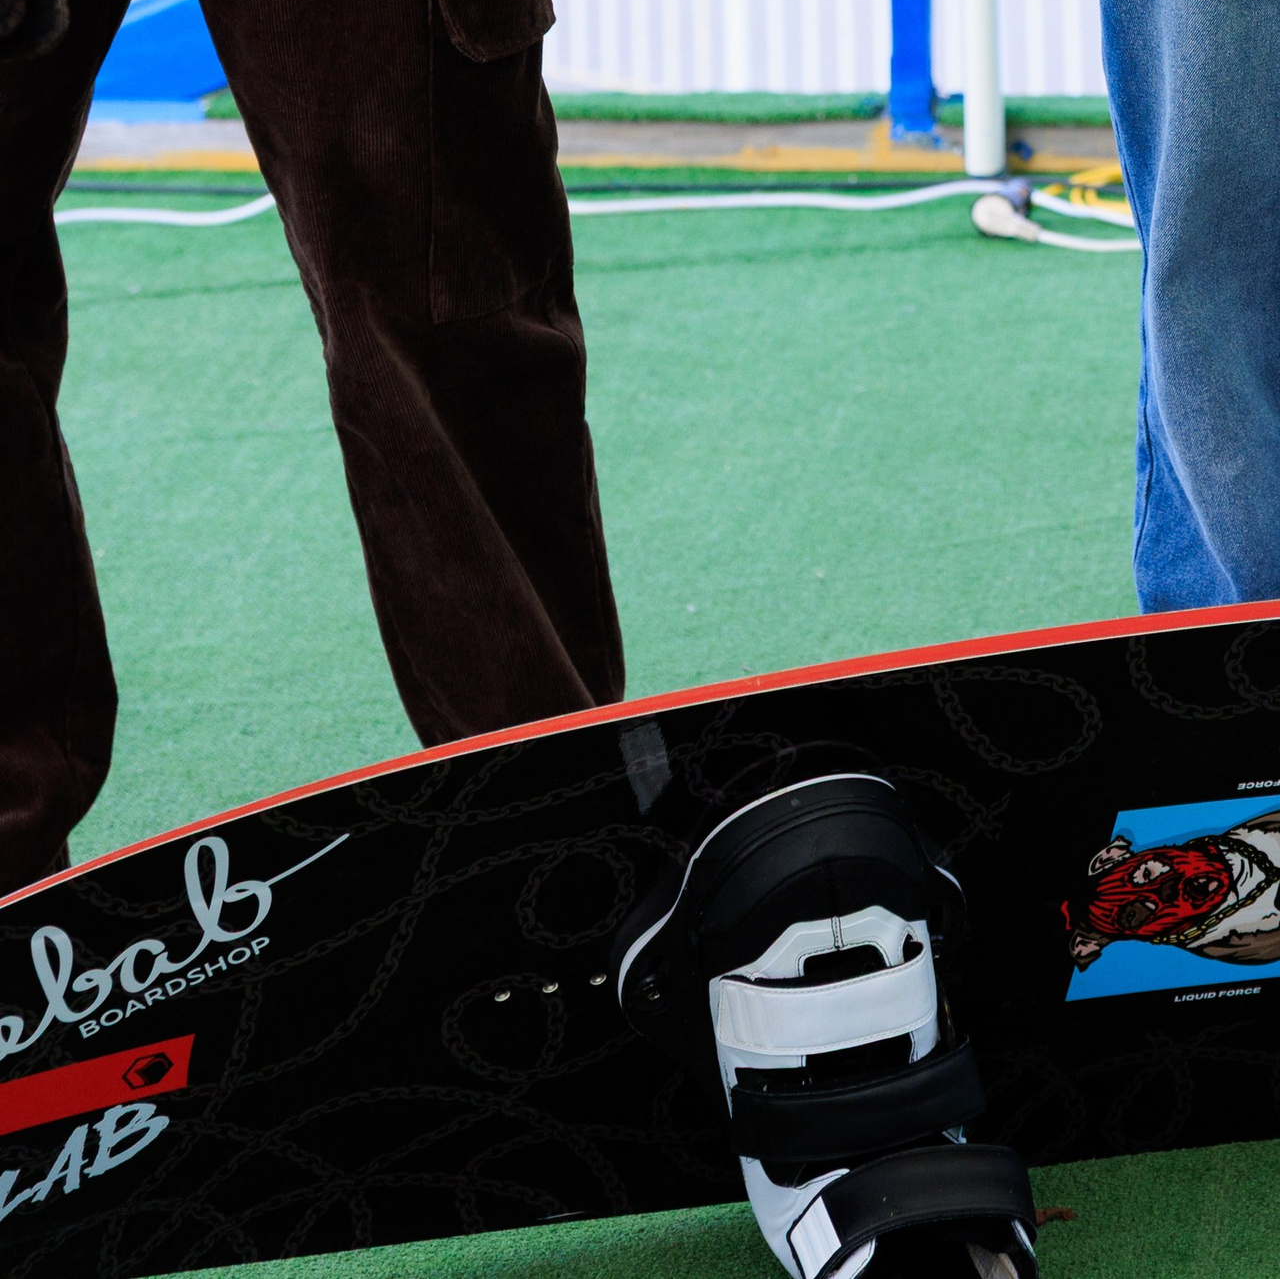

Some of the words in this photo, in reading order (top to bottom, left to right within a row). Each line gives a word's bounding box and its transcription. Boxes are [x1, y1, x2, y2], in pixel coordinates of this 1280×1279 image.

[1237, 779, 1280, 790] FORCE
[79, 936, 271, 1039] BOARDSHOP
[1174, 991, 1216, 1002] LIQUID
[1218, 987, 1261, 997] FORCE
